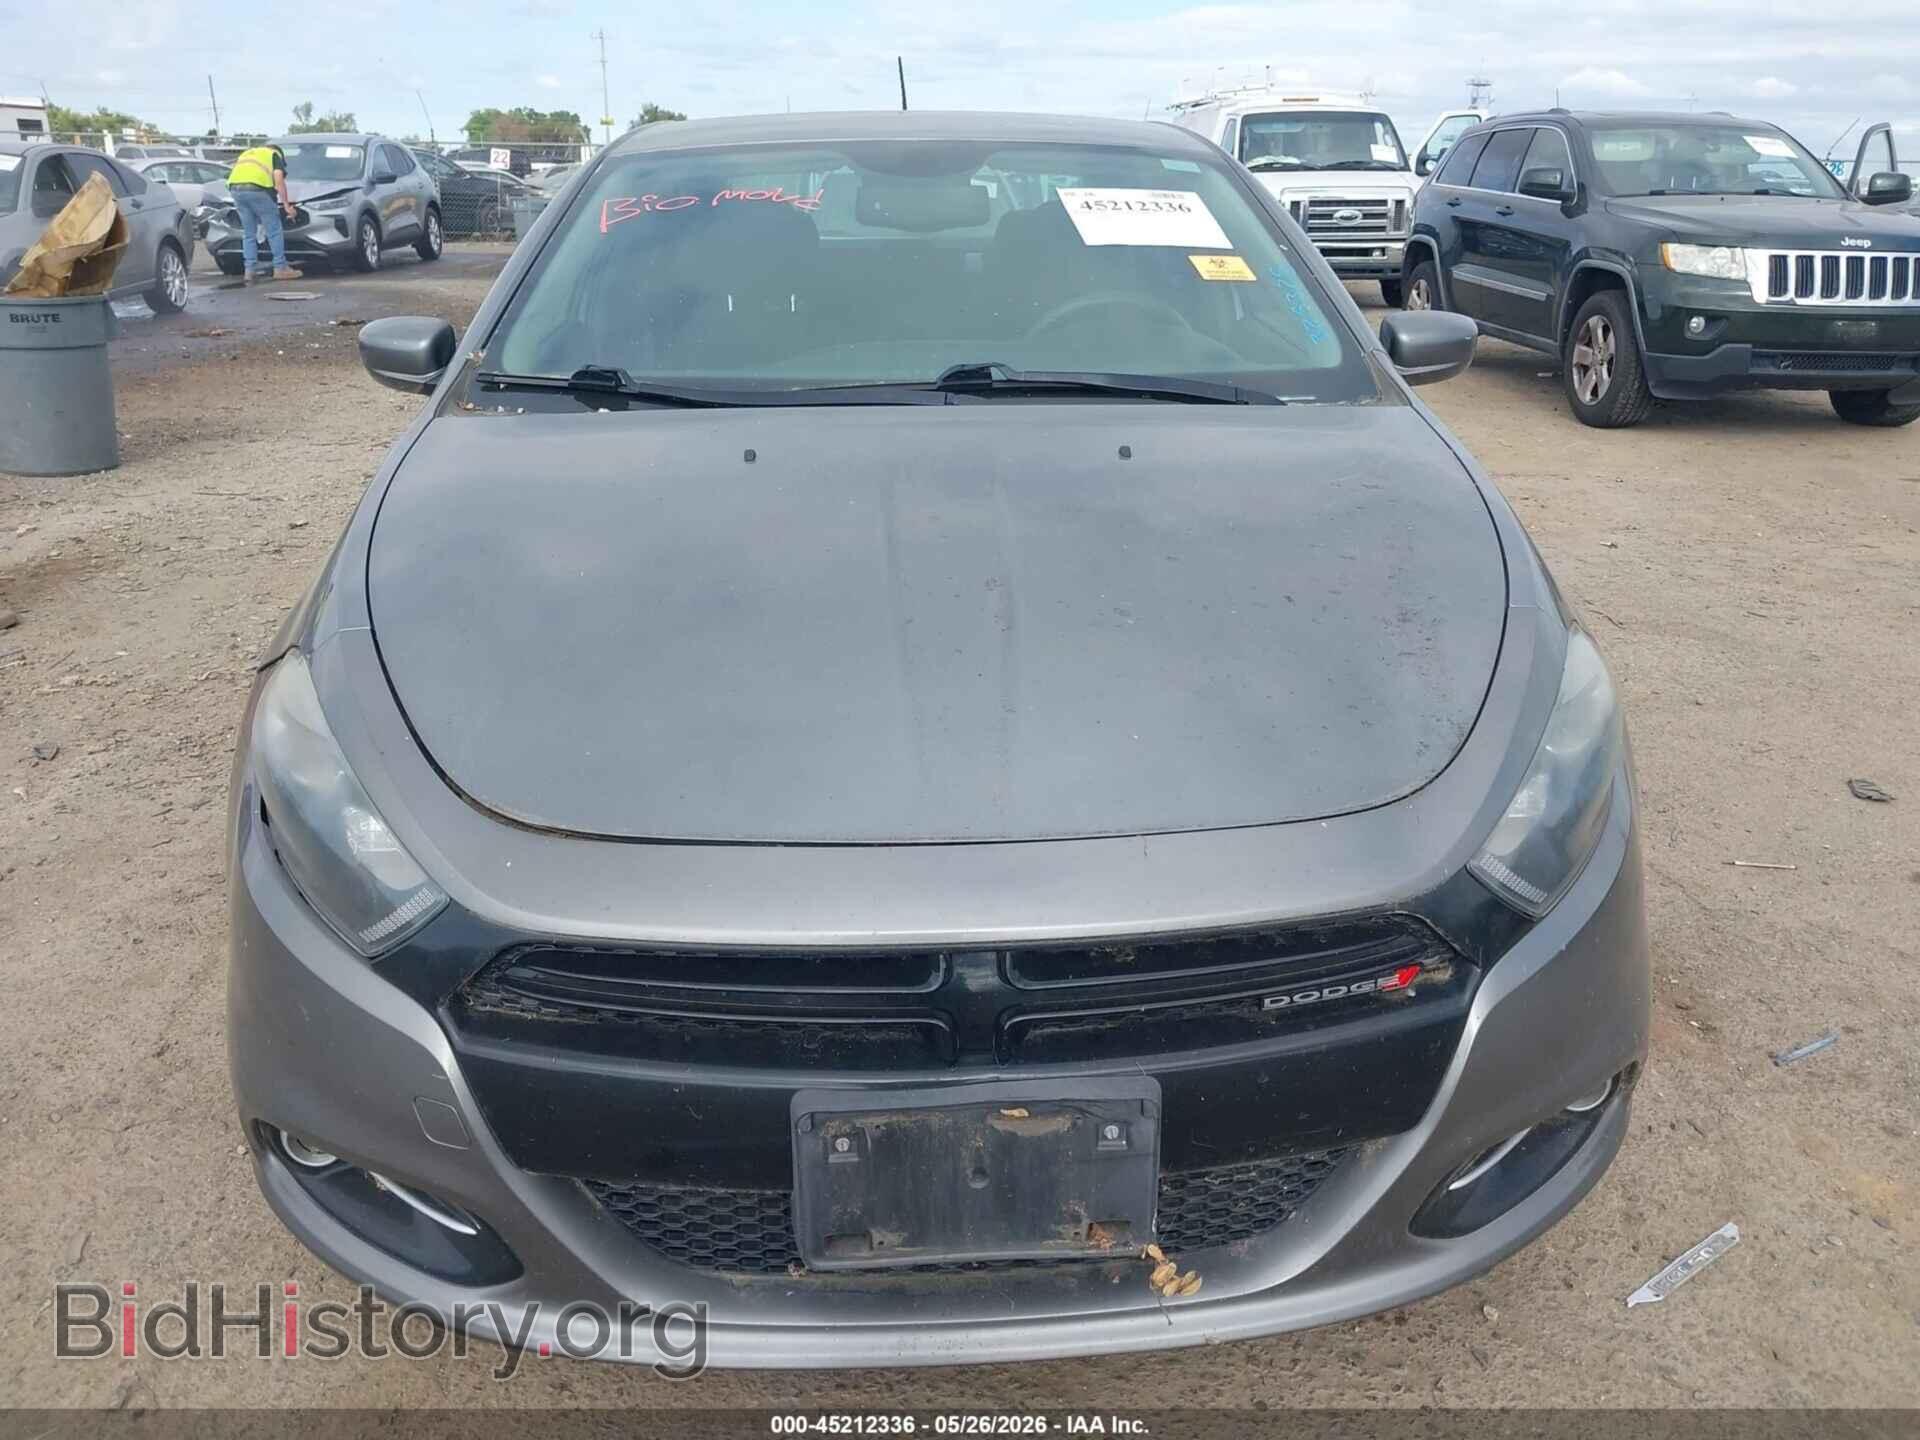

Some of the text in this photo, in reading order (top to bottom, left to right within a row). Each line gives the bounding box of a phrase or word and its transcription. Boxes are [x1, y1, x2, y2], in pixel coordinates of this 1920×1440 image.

[492, 150, 508, 164] 22
[1080, 200, 1192, 213] 45212336
[1840, 237, 1872, 249] Jeep
[9, 313, 61, 324] BRUTE
[1262, 974, 1403, 1011] DODGE
